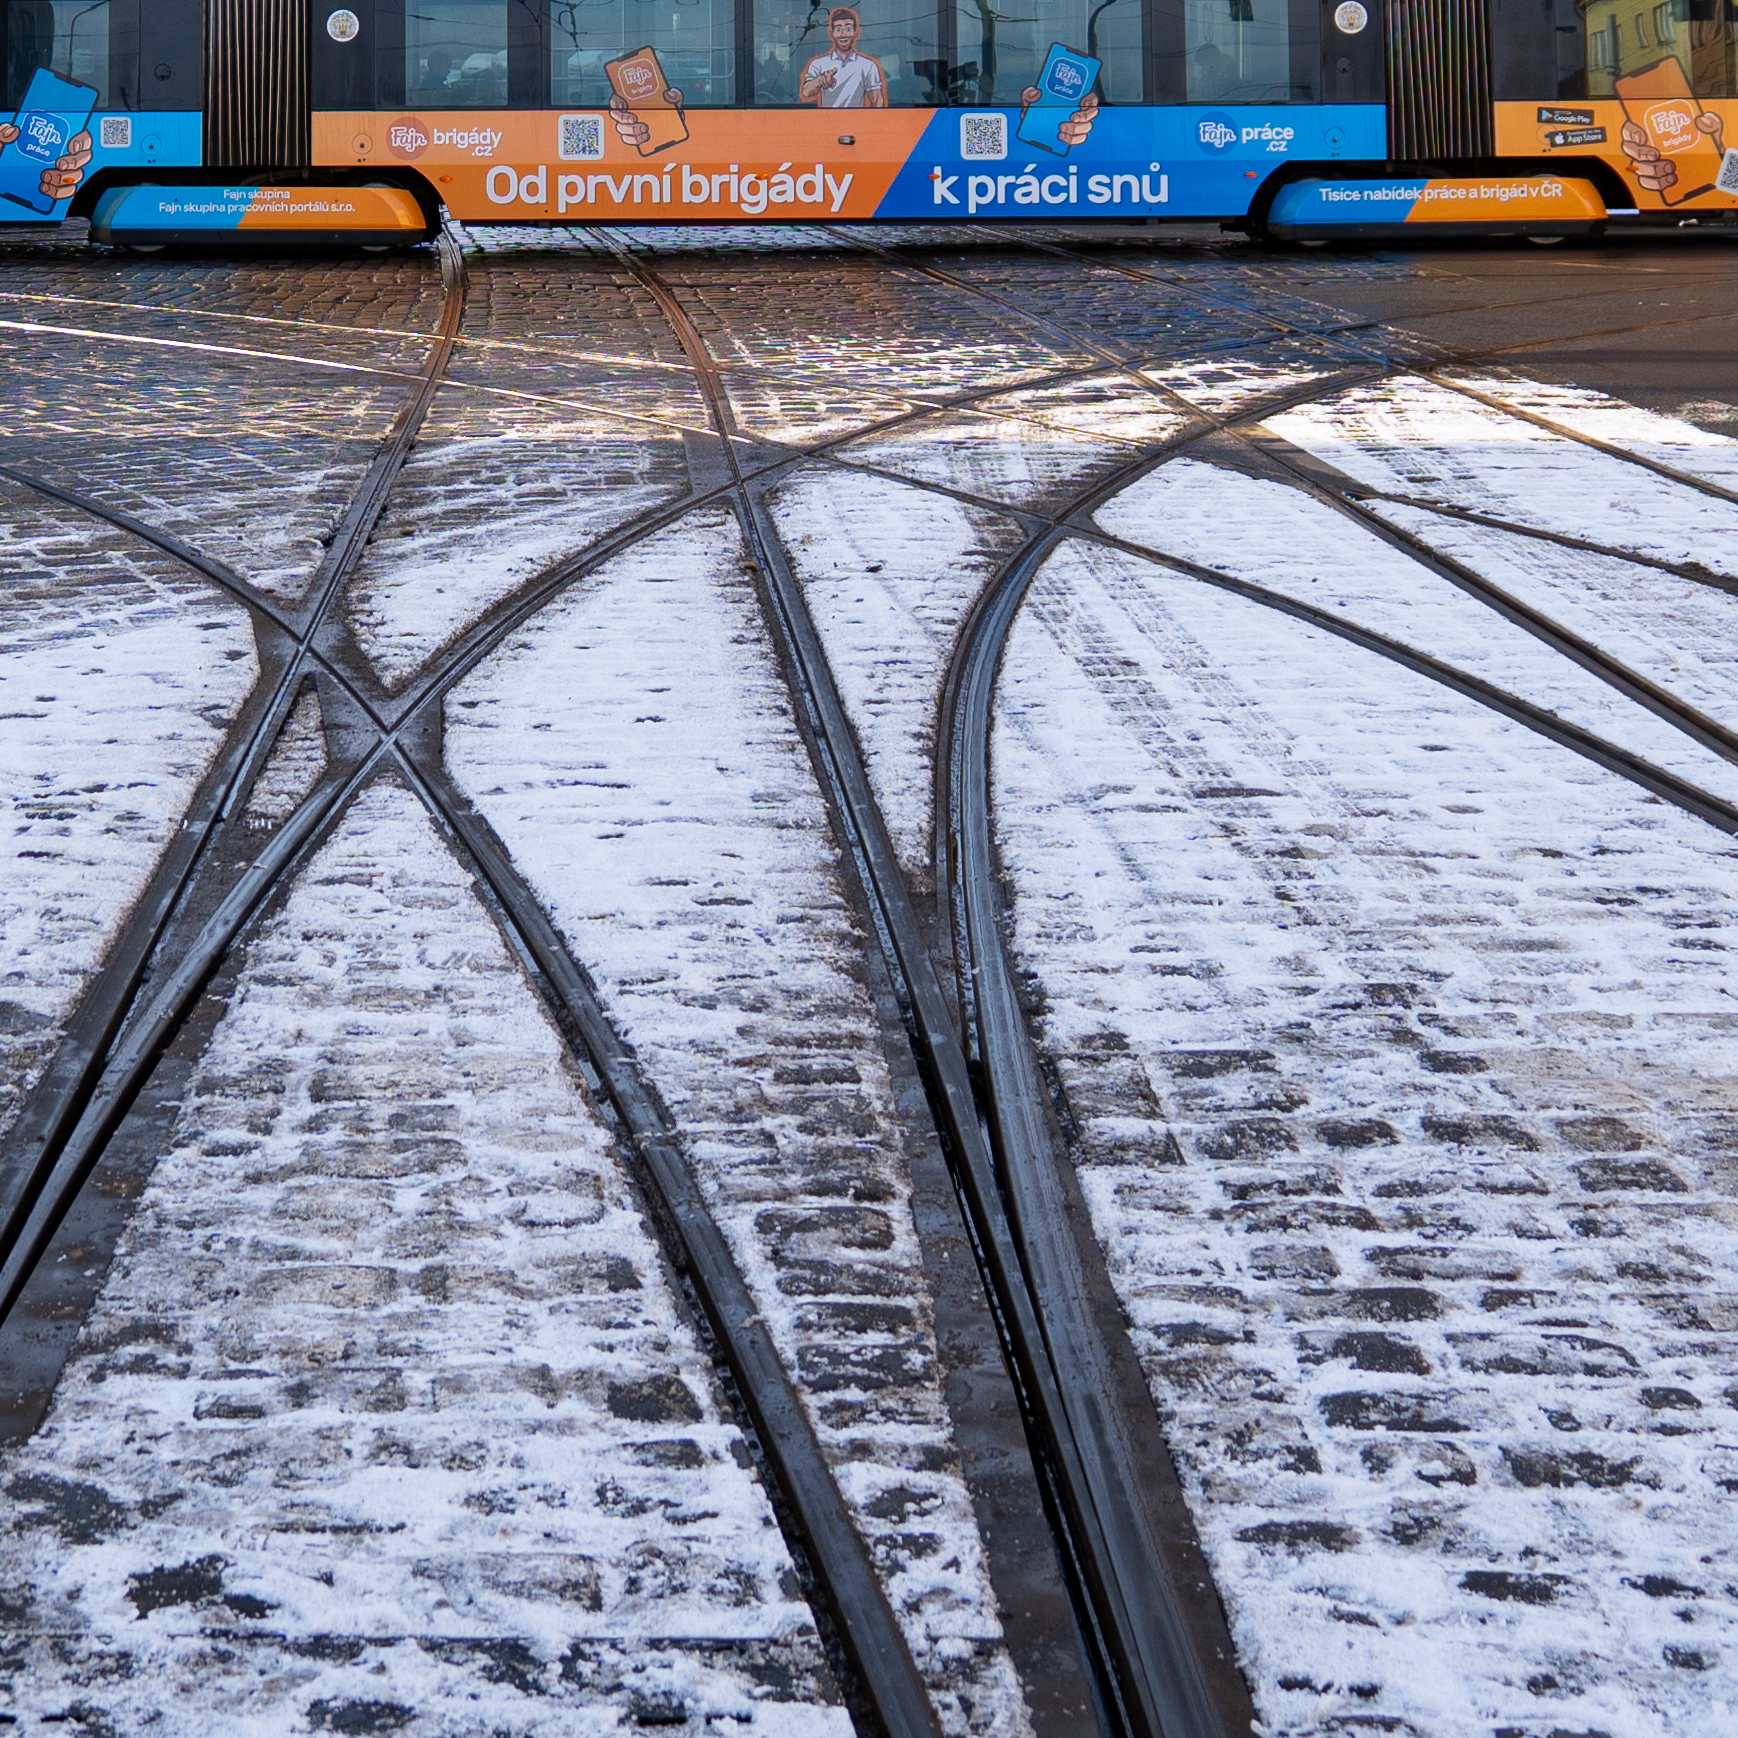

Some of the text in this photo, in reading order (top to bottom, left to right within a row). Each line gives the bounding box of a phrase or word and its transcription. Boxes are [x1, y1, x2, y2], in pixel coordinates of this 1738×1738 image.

[28, 116, 61, 145] Fajn
[1651, 110, 1691, 134] Fajn
[391, 126, 502, 152] Fajn brigády
[1199, 122, 1294, 148] Fajn práce
[1266, 140, 1288, 152] .cz
[471, 145, 493, 156] .cz
[223, 189, 290, 201] Fajn skupina
[486, 162, 853, 213] Od první brigády
[933, 162, 1169, 214] k práci snů
[1319, 180, 1563, 202] Tisíce nabídek práce a brigád v ČR
[159, 201, 356, 214] Fajn skupina pracovních portálů s.r.o.
